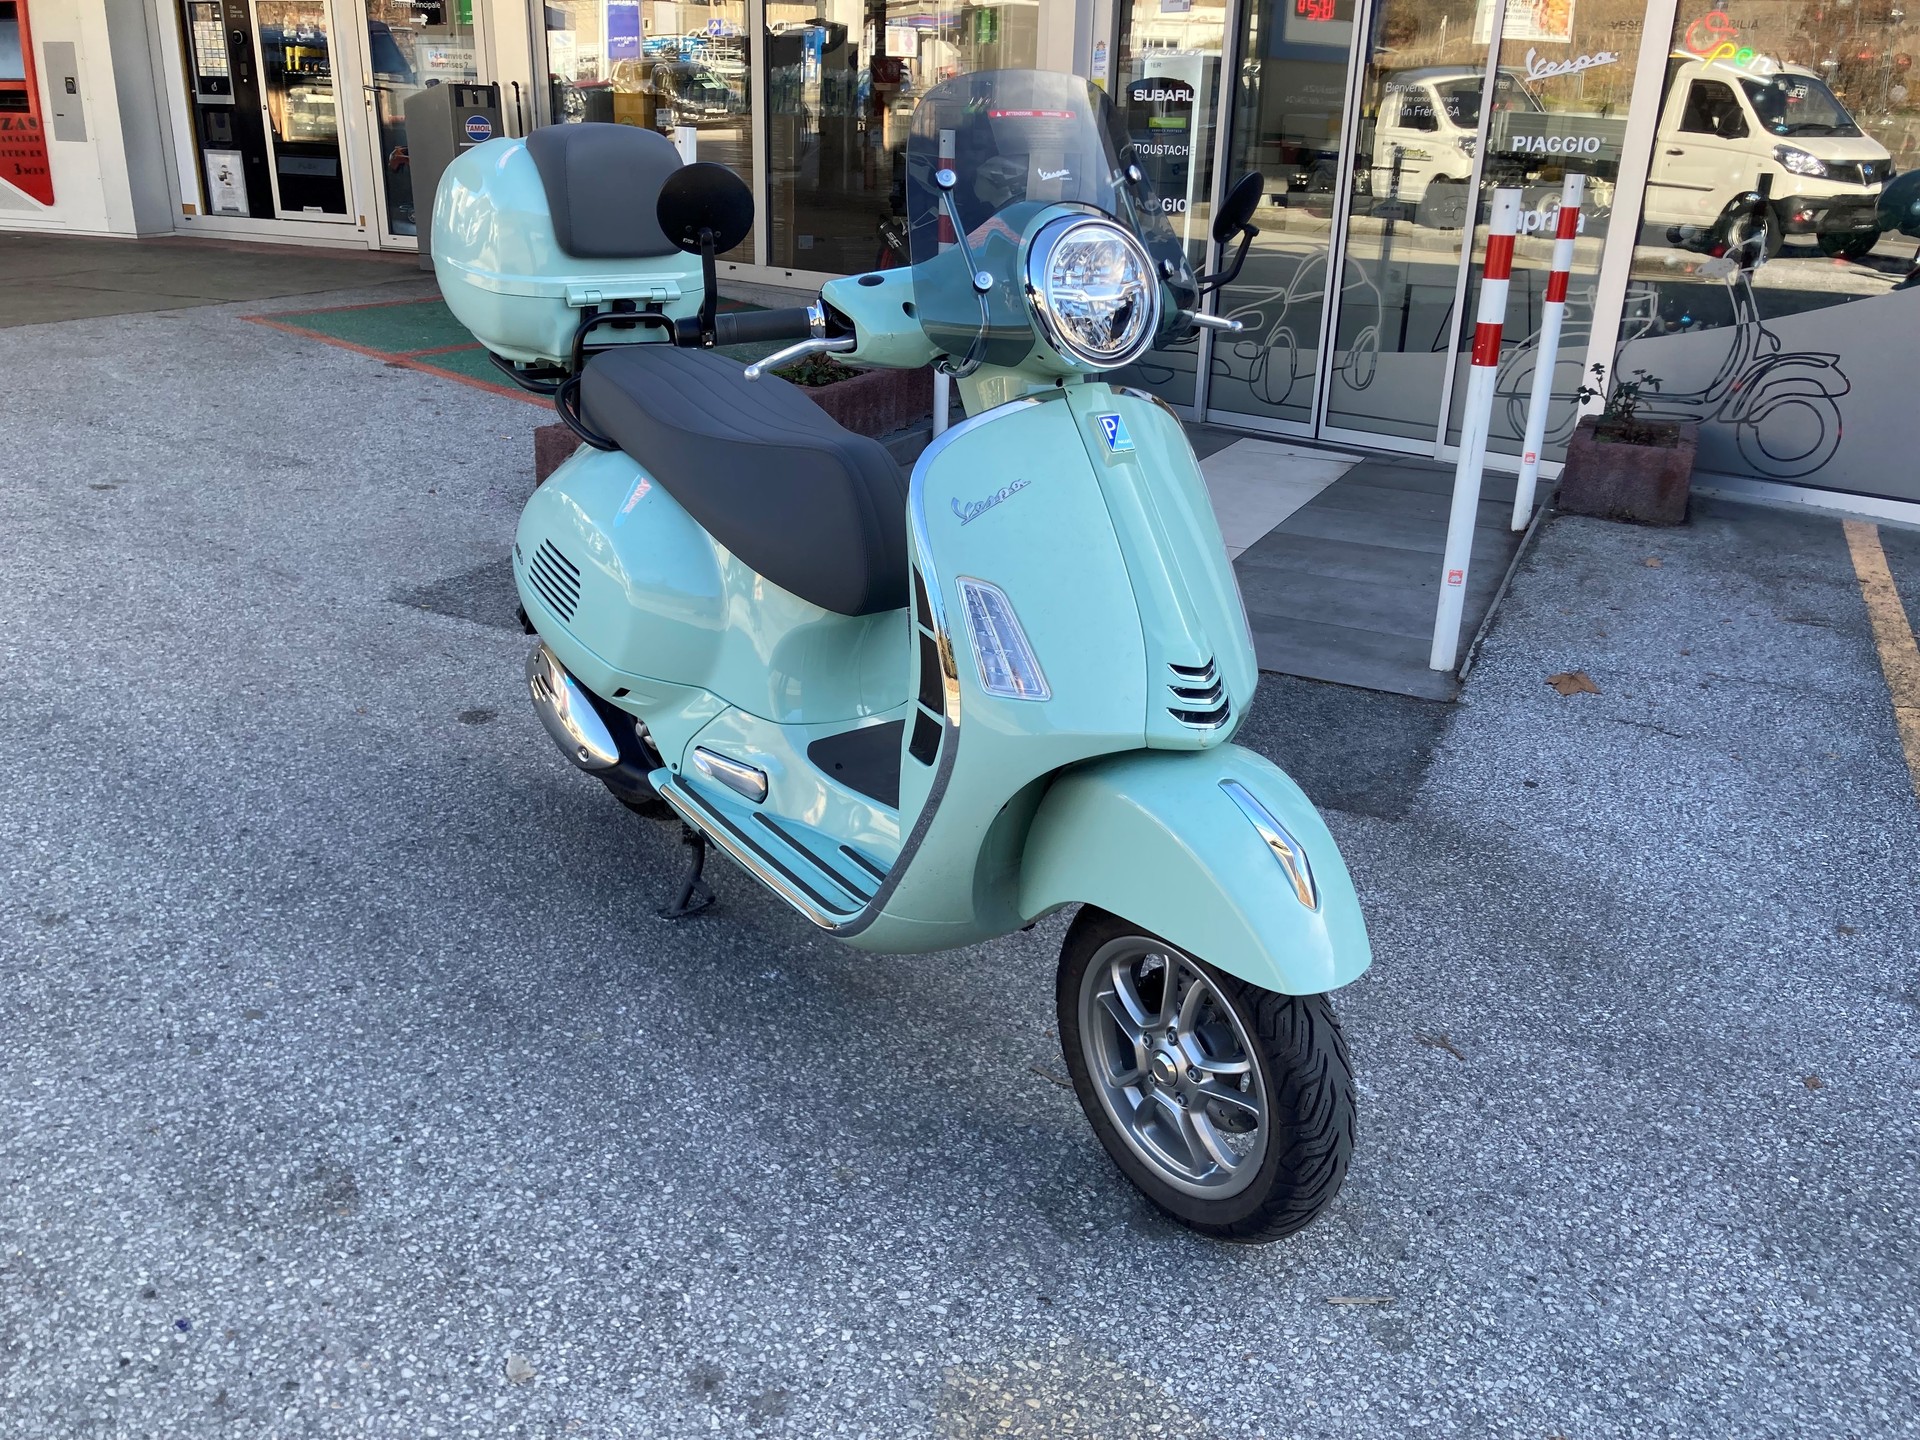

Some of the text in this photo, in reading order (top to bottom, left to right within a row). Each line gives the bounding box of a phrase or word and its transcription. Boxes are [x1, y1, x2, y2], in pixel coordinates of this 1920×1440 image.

[1525, 47, 1619, 82] Vespa
[466, 124, 491, 132] TAMOIL
[1512, 135, 1600, 153] PIAGGIO
[951, 478, 1032, 527] Vespa
